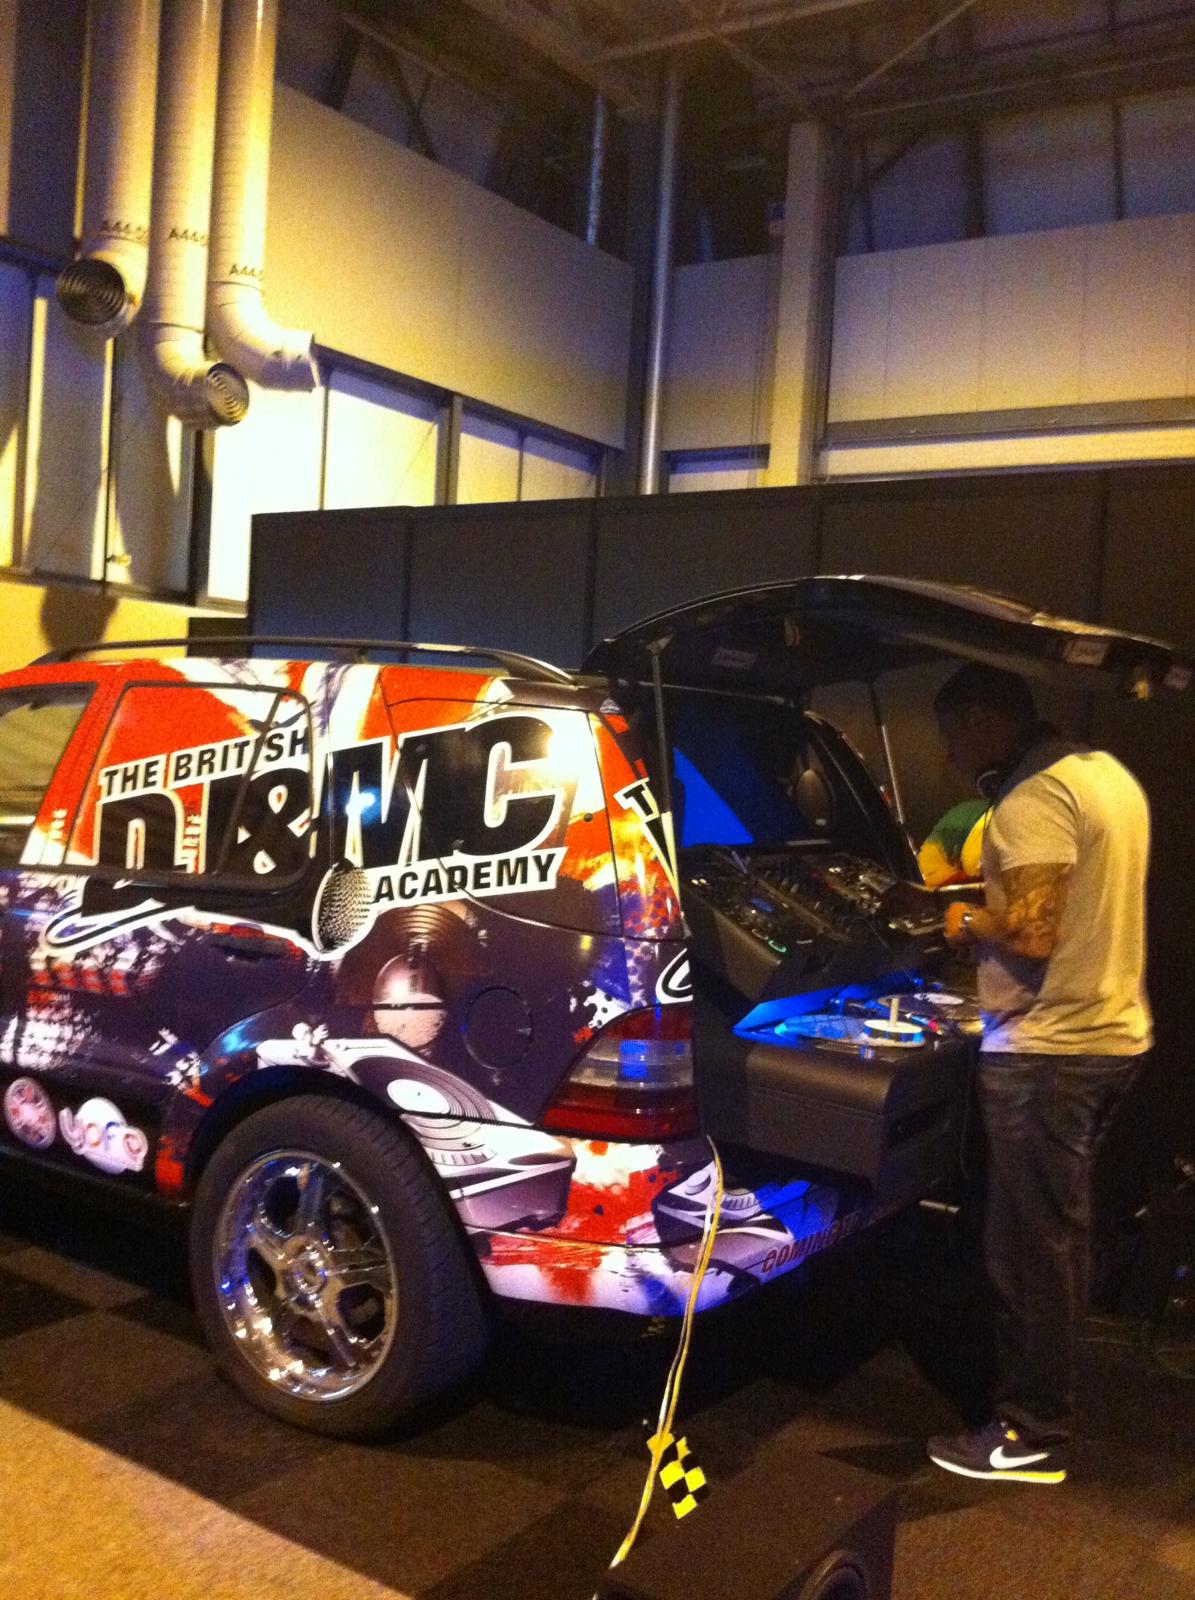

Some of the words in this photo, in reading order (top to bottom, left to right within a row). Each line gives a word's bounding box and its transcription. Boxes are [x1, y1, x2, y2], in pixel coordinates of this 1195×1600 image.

[104, 760, 161, 796] THE
[173, 727, 308, 783] BRITSH
[374, 852, 556, 903] ACADEMY
